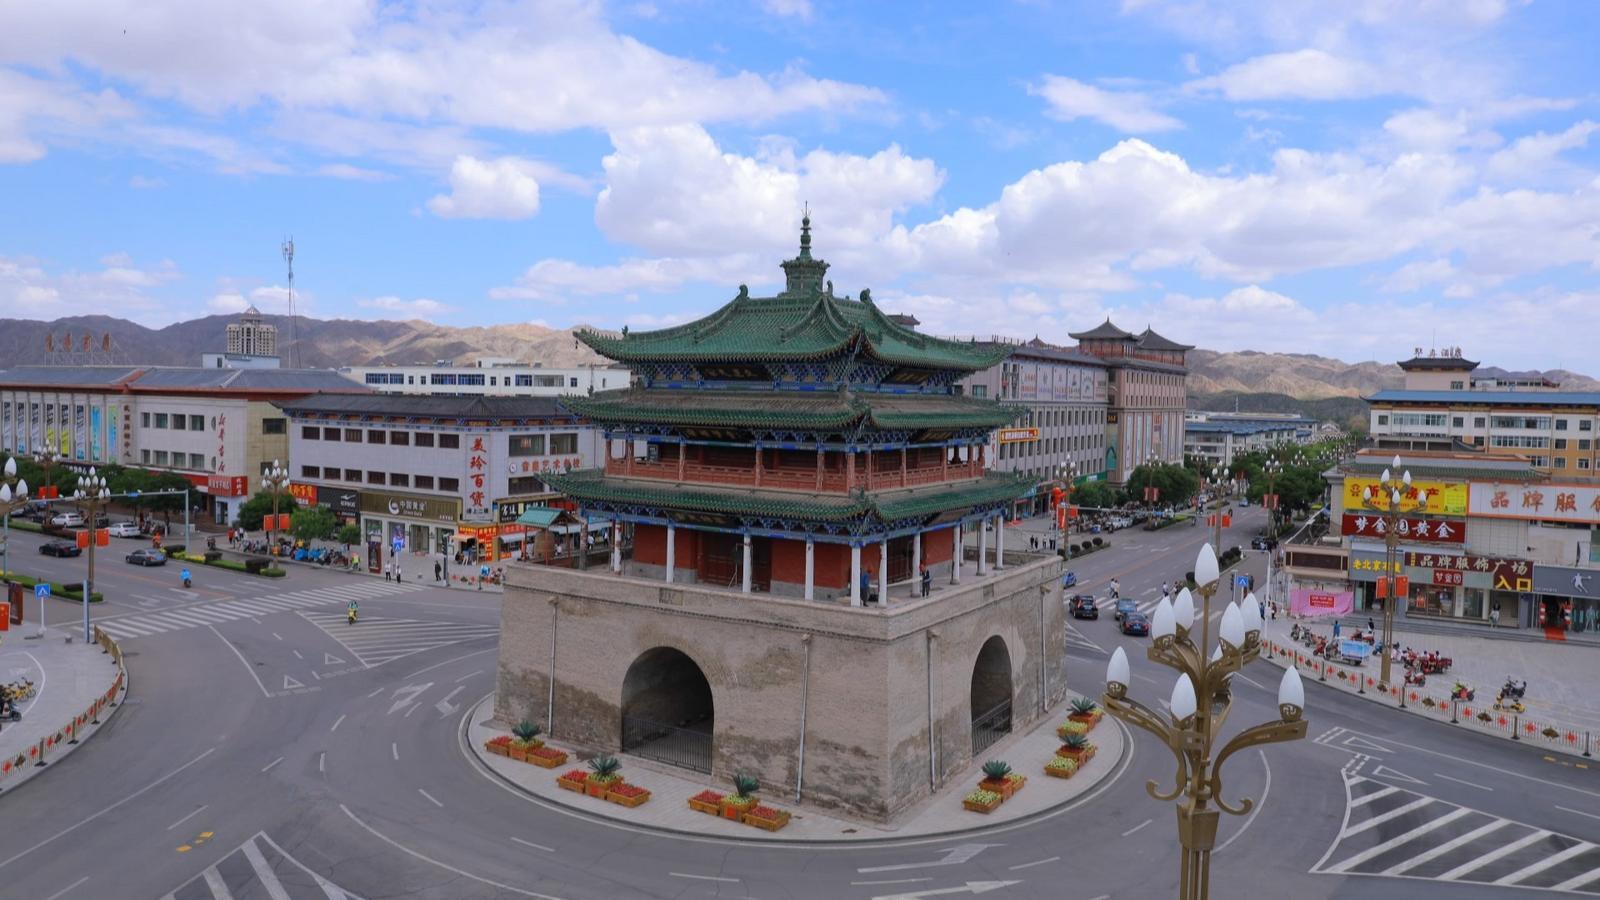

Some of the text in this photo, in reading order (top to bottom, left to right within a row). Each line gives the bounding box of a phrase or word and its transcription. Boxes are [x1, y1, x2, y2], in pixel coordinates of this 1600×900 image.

[470, 437, 487, 508] 美玲百货
[1368, 484, 1440, 501] 新房产
[1420, 554, 1528, 576] 品牌服饰广场
[1495, 575, 1531, 592] 入口
